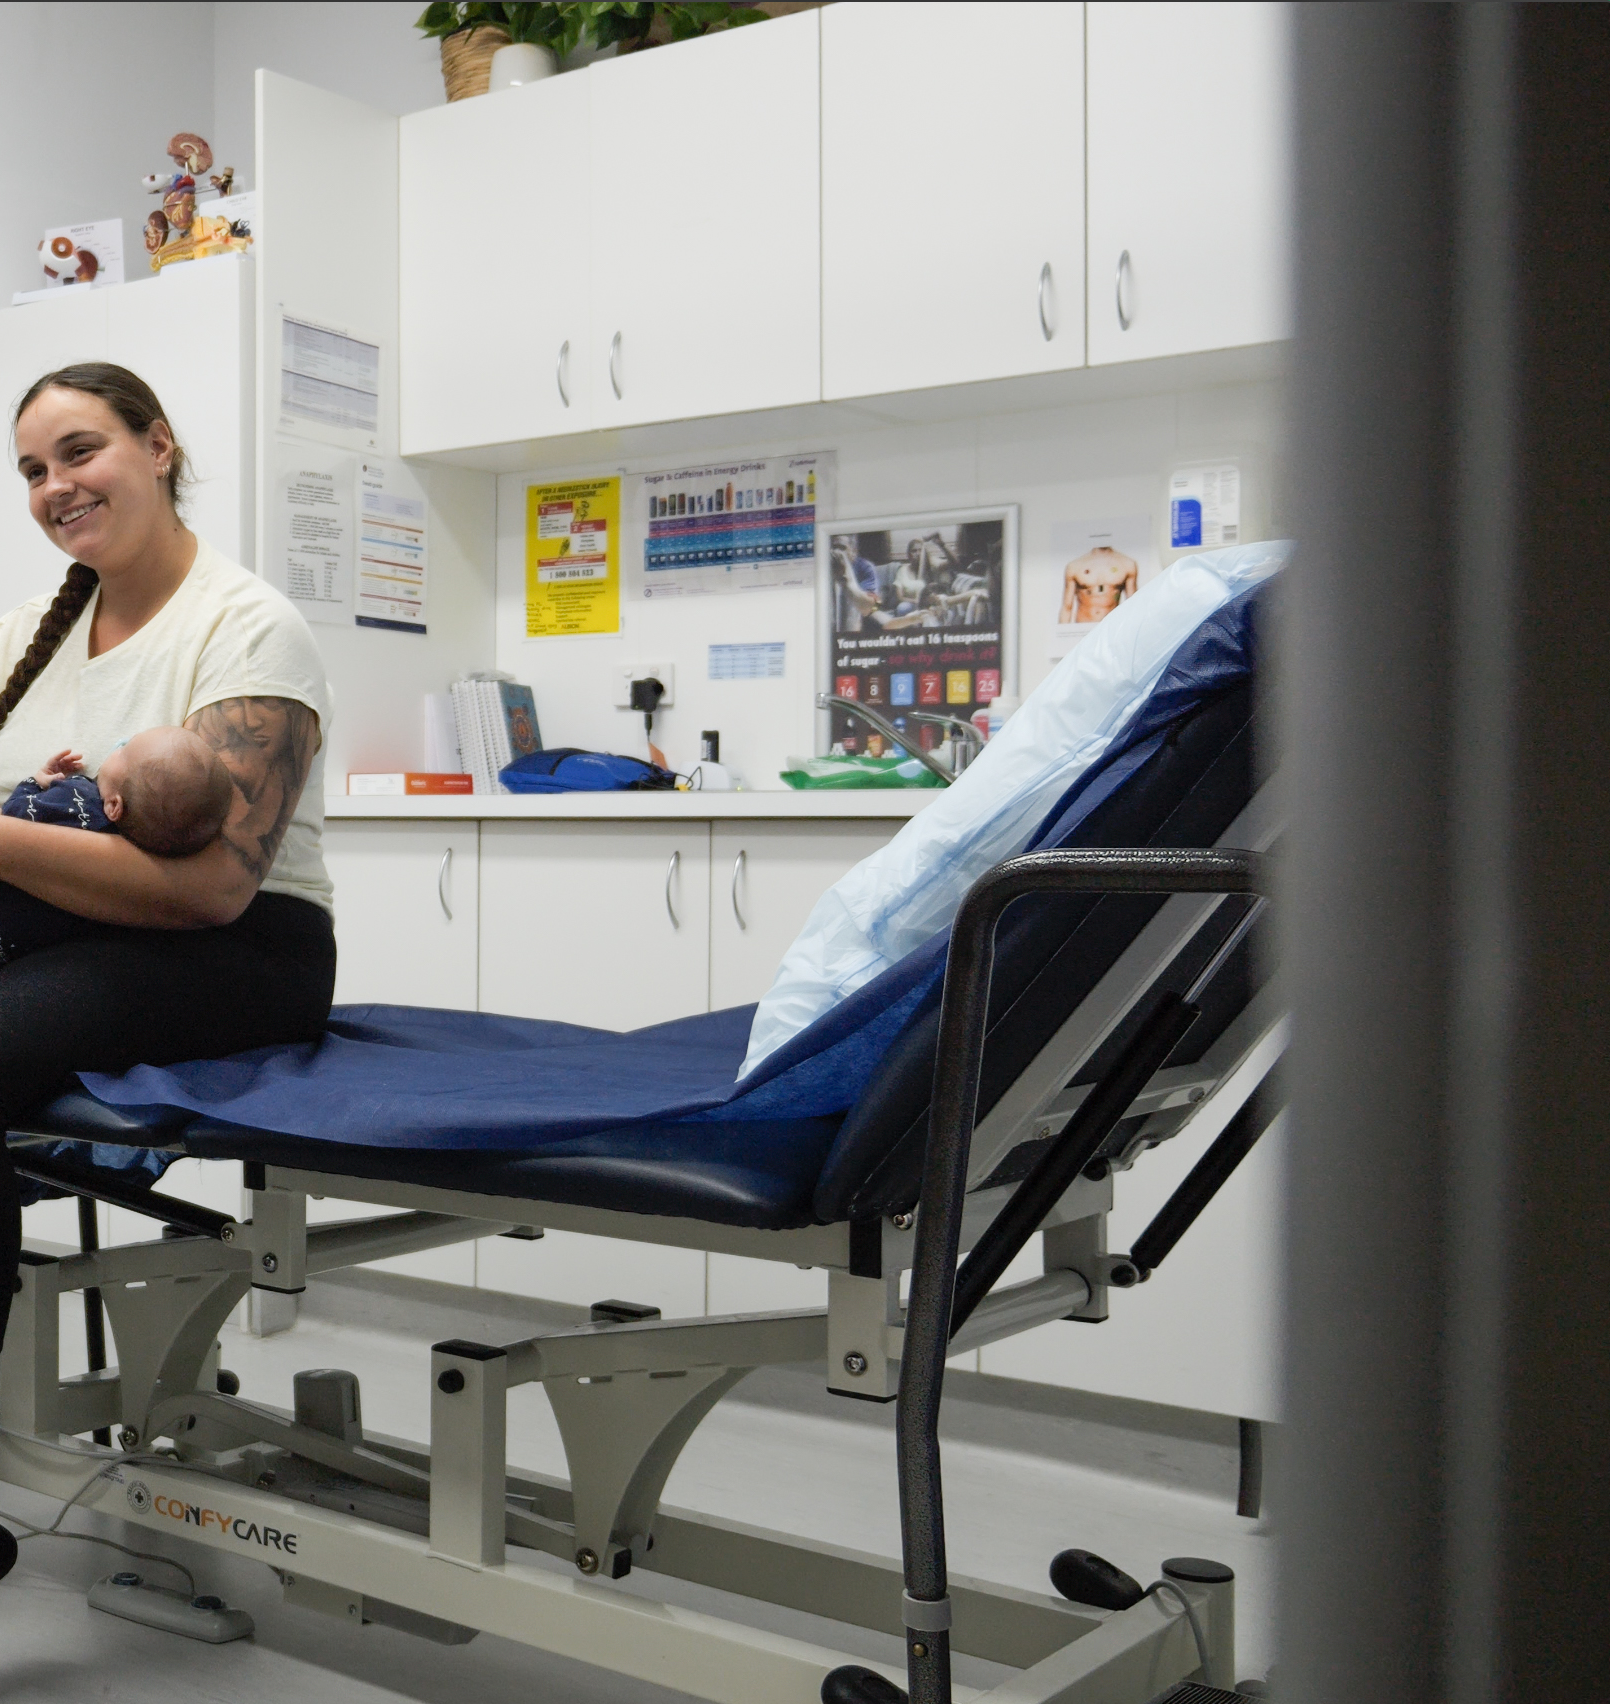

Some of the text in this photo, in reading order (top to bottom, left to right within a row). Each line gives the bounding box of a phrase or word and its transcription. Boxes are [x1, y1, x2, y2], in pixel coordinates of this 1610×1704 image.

[644, 475, 664, 484] Sugar
[673, 470, 703, 479] Caffeine
[713, 466, 739, 475] Energy
[740, 462, 765, 471] Drinks
[837, 632, 998, 648] You wouldn't eat 16 teaspoons
[837, 656, 850, 667] of
[850, 656, 880, 668] sugar
[889, 655, 904, 664] so
[908, 650, 934, 666] why
[939, 647, 974, 662] drink
[840, 686, 854, 696] 16
[870, 685, 879, 695] 8
[898, 684, 905, 694] 9
[925, 683, 934, 694] 7
[952, 682, 965, 692] 16
[979, 680, 994, 692] 25
